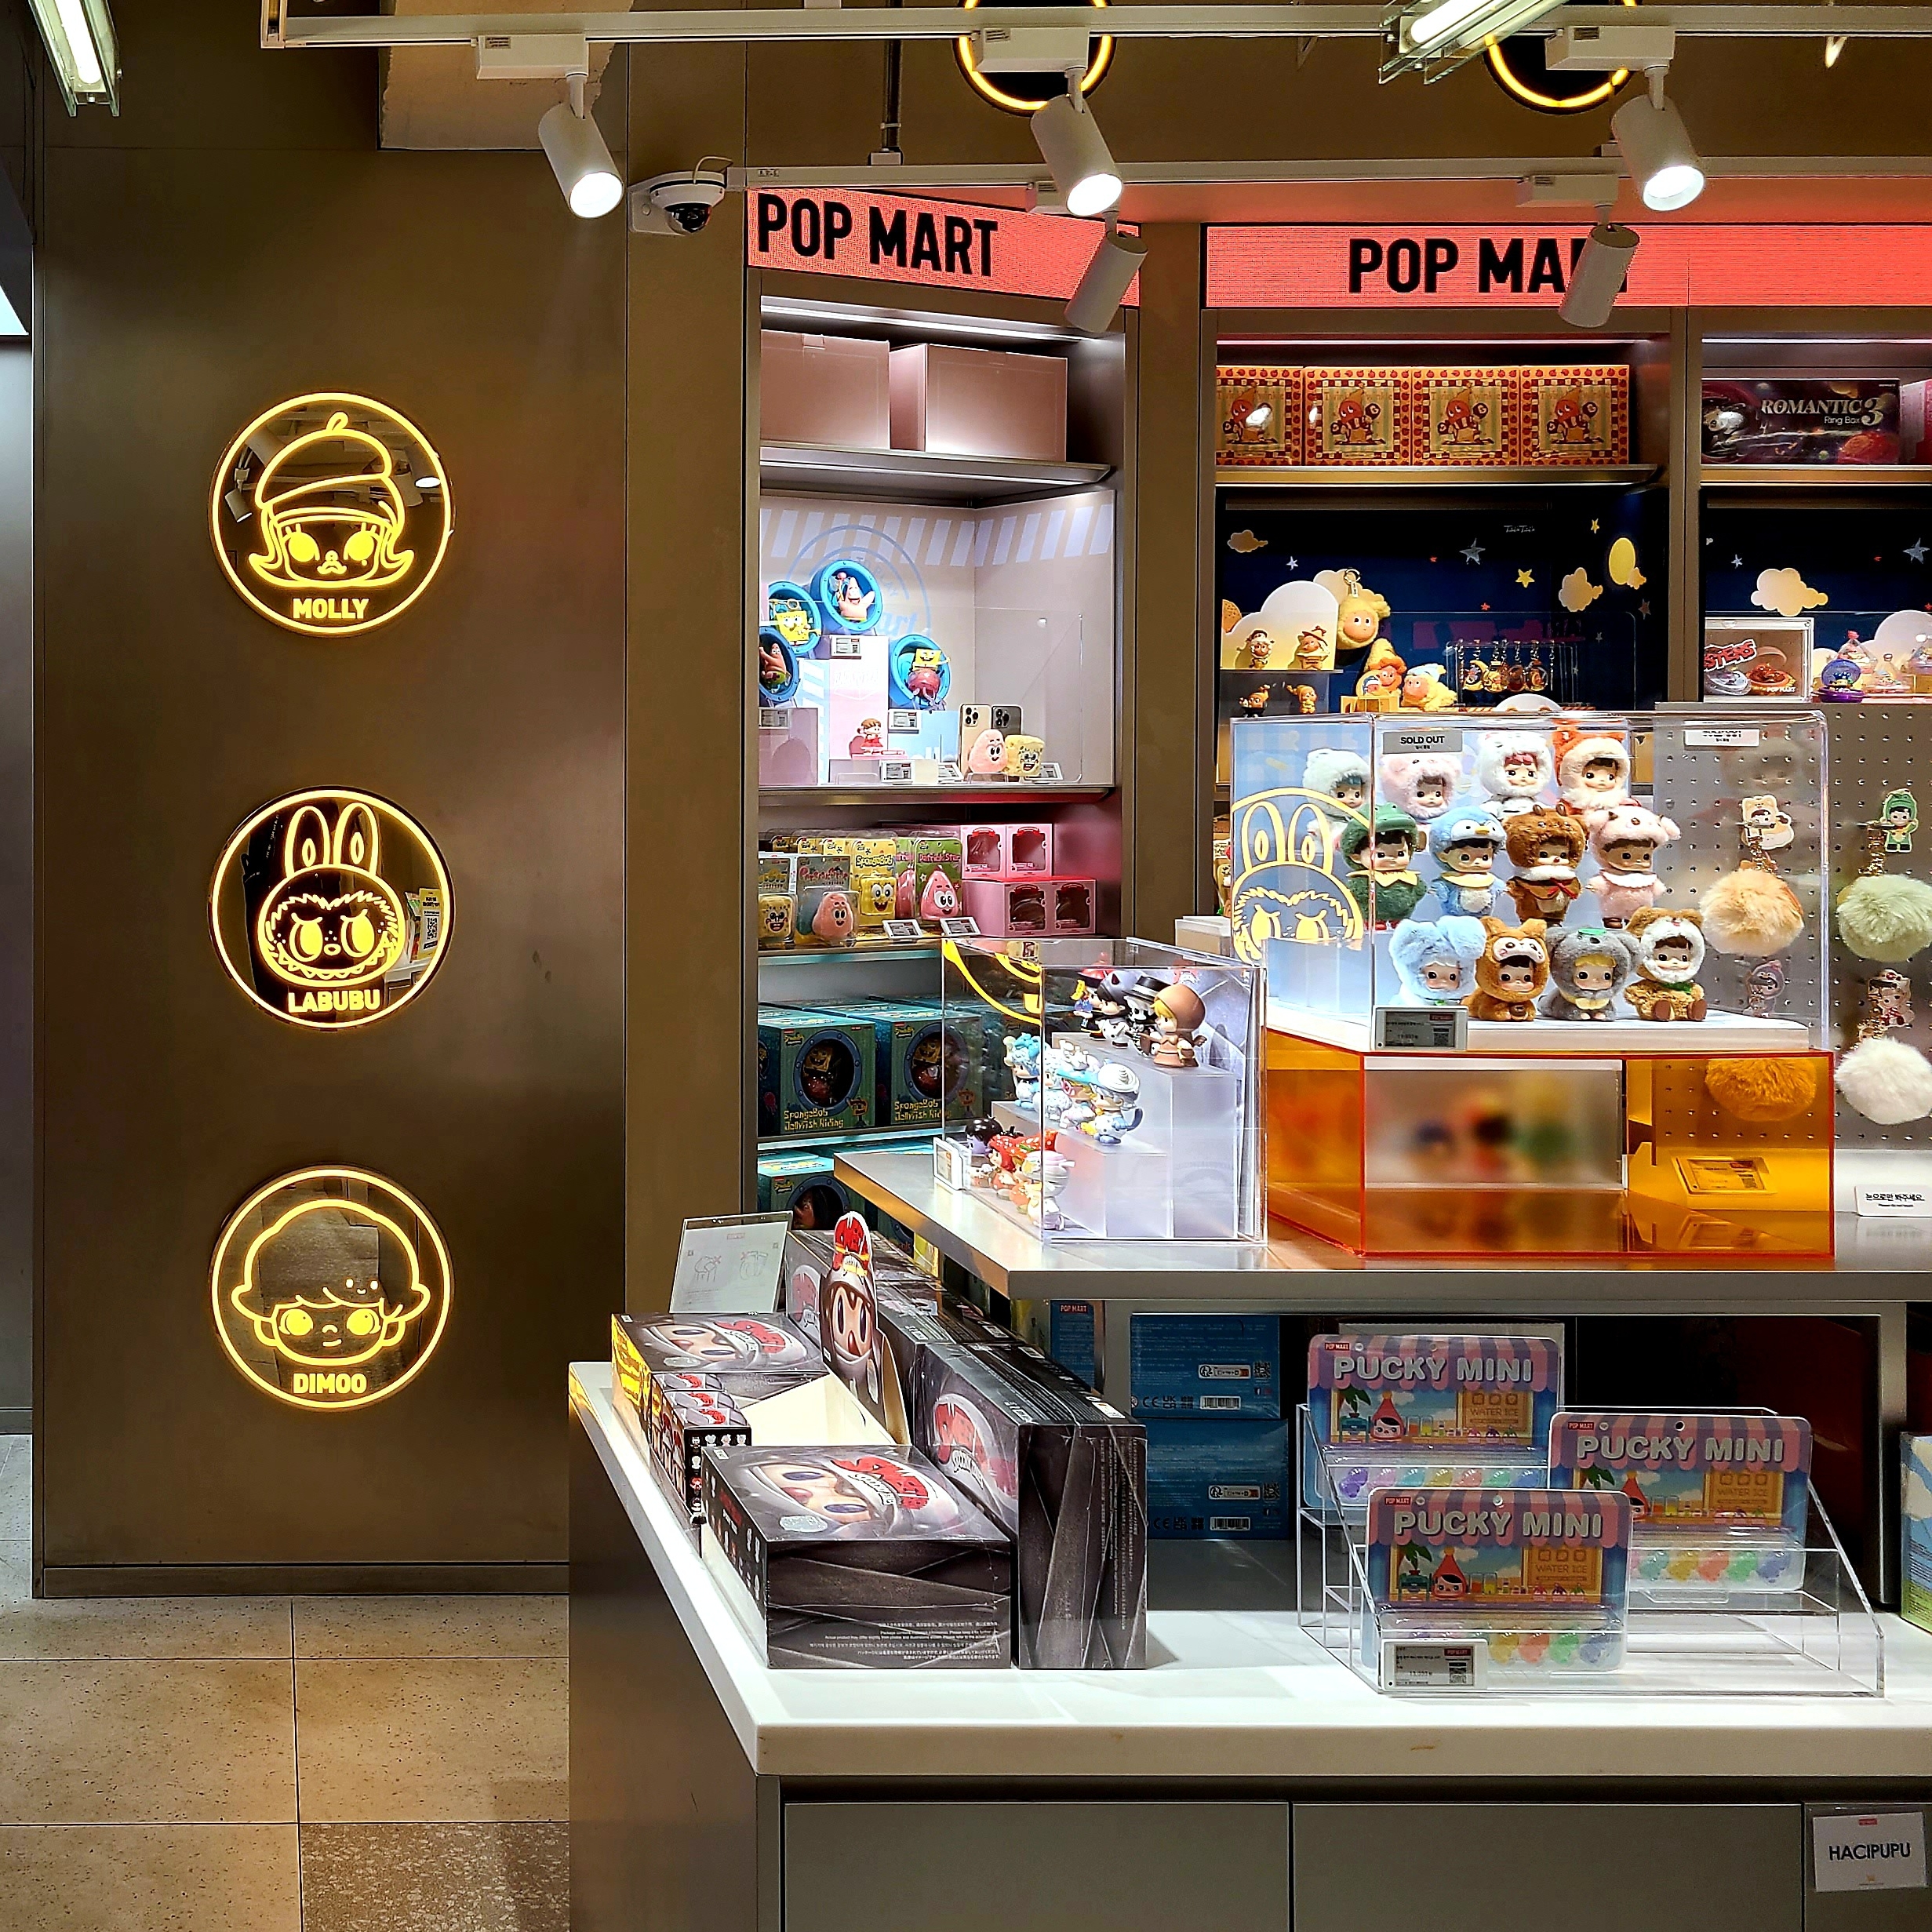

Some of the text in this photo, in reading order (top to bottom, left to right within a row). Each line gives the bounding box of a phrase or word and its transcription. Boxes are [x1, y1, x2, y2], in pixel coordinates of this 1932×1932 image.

[758, 193, 998, 278] POP MART
[1348, 238, 1628, 293] POP MA
[1761, 397, 1883, 425] ROMANTIC 3
[1824, 416, 1843, 426] Ring
[293, 598, 369, 619] MOLLY
[856, 855, 893, 868] SpongeBob
[918, 853, 942, 863] Patrick
[288, 989, 380, 1013] LABUBU
[784, 1108, 828, 1120] SpongeBob
[894, 1099, 939, 1112] SpongeBob
[784, 1118, 844, 1130] Jellyfish Riding
[1072, 1304, 1088, 1313] MART
[1333, 1355, 1534, 1382] PUCKY MINI
[293, 1373, 367, 1394] DIMOO
[1469, 1408, 1519, 1417] WATER ICE
[1577, 1435, 1785, 1462] PUCKY MINI
[1394, 1511, 1603, 1537] PUCKY MINI
[1535, 1565, 1588, 1574] WATER ICE
[1828, 1843, 1911, 1861] HACIPUPU
